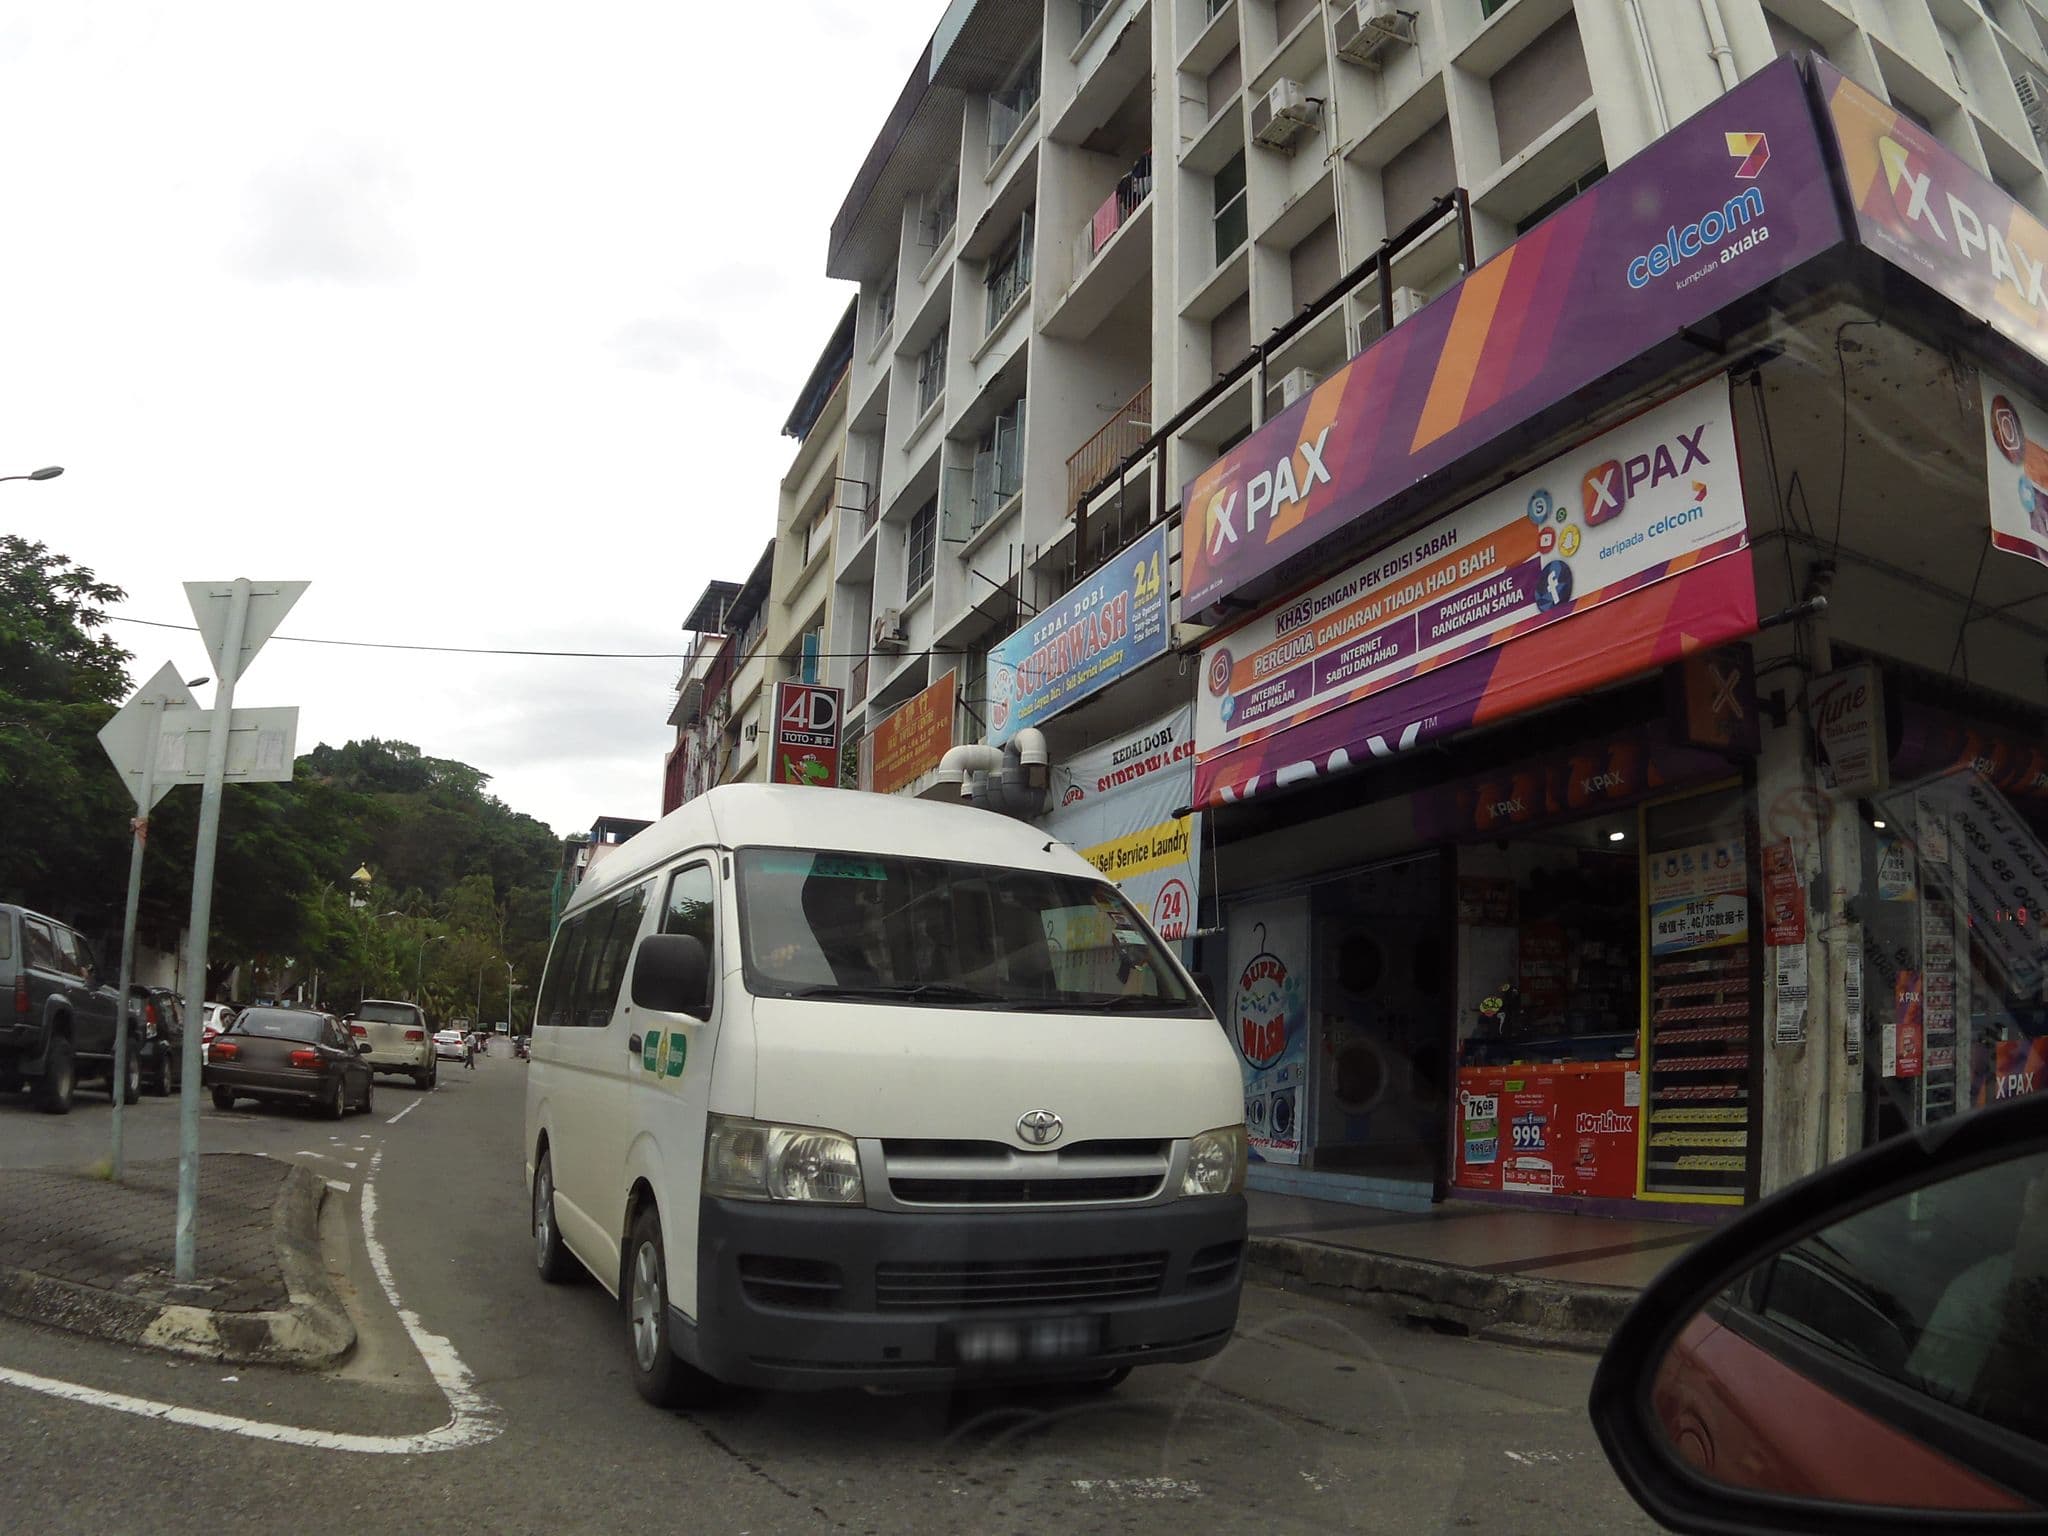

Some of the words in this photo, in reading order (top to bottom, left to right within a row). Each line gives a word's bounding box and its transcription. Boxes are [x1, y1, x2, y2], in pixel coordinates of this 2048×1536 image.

[1627, 187, 1765, 288] celcom
[1676, 261, 1718, 290] kumpulan
[1720, 226, 1770, 264] axiata
[1599, 532, 1644, 560] daripada
[1648, 505, 1703, 538] celcom
[1133, 551, 1162, 600] 24
[1276, 599, 1312, 638] KHAS
[1314, 582, 1358, 615] DENGAN
[1359, 568, 1381, 592] PEK
[1383, 555, 1413, 582] EDISI
[1415, 529, 1457, 563] SABAH
[1033, 612, 1068, 645] KEDAI
[1074, 586, 1105, 617] DOBI
[1253, 632, 1315, 679] PERCUMA
[1318, 602, 1382, 645] GANJARAN
[1384, 581, 1424, 613] TIADA
[1426, 565, 1456, 594] HAD
[1459, 545, 1496, 577] BAH!
[1431, 602, 1490, 638] RANGKAIAN
[1492, 588, 1523, 612] SAMA
[1440, 583, 1497, 620] PANGGILAN
[1499, 577, 1513, 594] KE
[1015, 590, 1128, 702] SUPERWASH
[1326, 665, 1353, 685] SABTU
[1353, 658, 1373, 674] DAN
[1373, 644, 1398, 664] AHAD
[1340, 636, 1382, 665] INTERNET
[1077, 664, 1098, 684] Service
[1251, 679, 1287, 705] INTERNET
[783, 690, 836, 730] 4D
[1242, 702, 1267, 720] LEWAT
[1267, 689, 1295, 711] MALAM
[785, 733, 809, 743] TOTO
[1112, 740, 1142, 766] KEDAI
[1143, 727, 1174, 752] DOBI
[1117, 843, 1149, 868] Service
[1152, 830, 1189, 858] Laundry
[1161, 891, 1182, 920] 24
[1242, 1013, 1284, 1061] WASH
